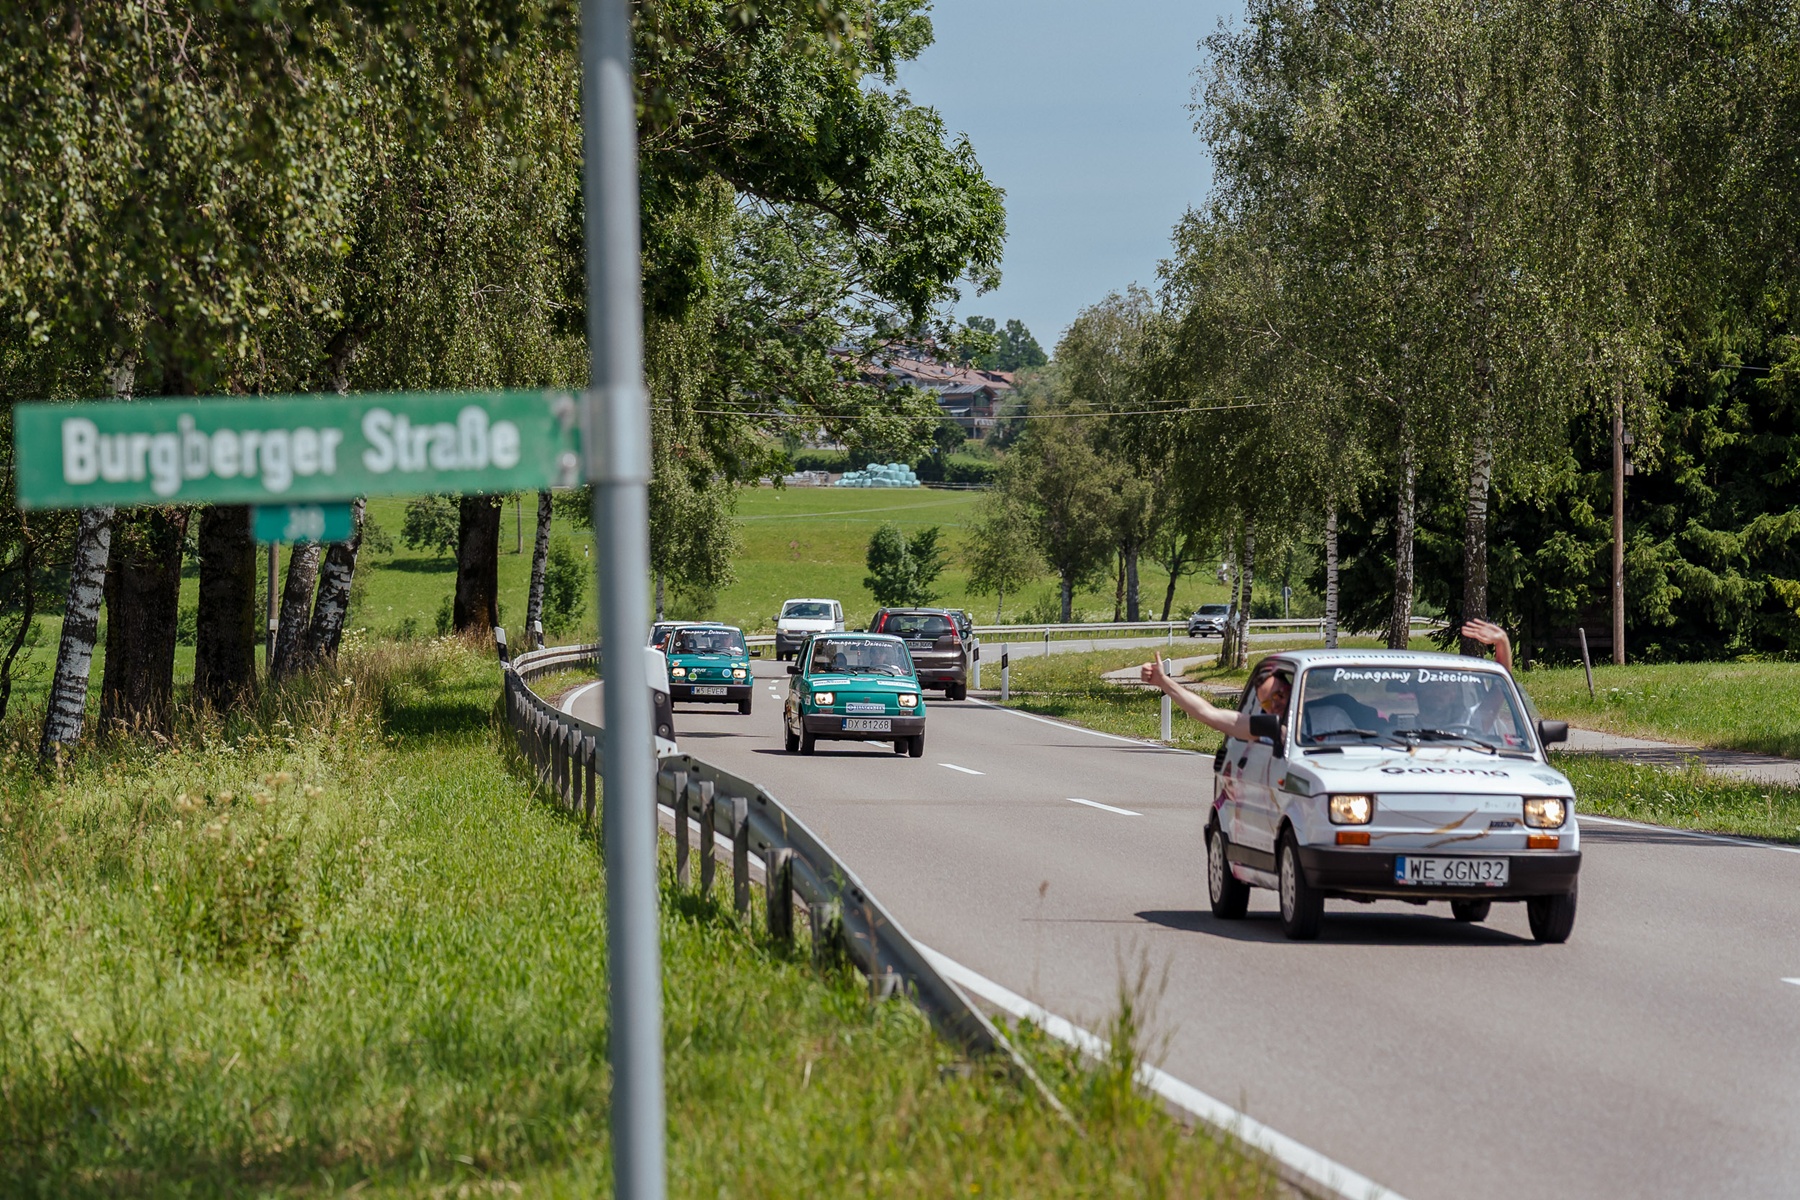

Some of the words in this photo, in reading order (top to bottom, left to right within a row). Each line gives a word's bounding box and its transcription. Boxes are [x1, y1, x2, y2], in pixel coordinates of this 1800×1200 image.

[61, 413, 342, 497] Burgberger
[361, 405, 522, 474] Straße
[1334, 668, 1411, 683] Pomagamy
[1419, 669, 1482, 683] Dzieciom
[848, 719, 861, 729] DX
[862, 720, 890, 730] 81268
[1410, 859, 1436, 880] WE
[1443, 860, 1505, 881] 6GN32
